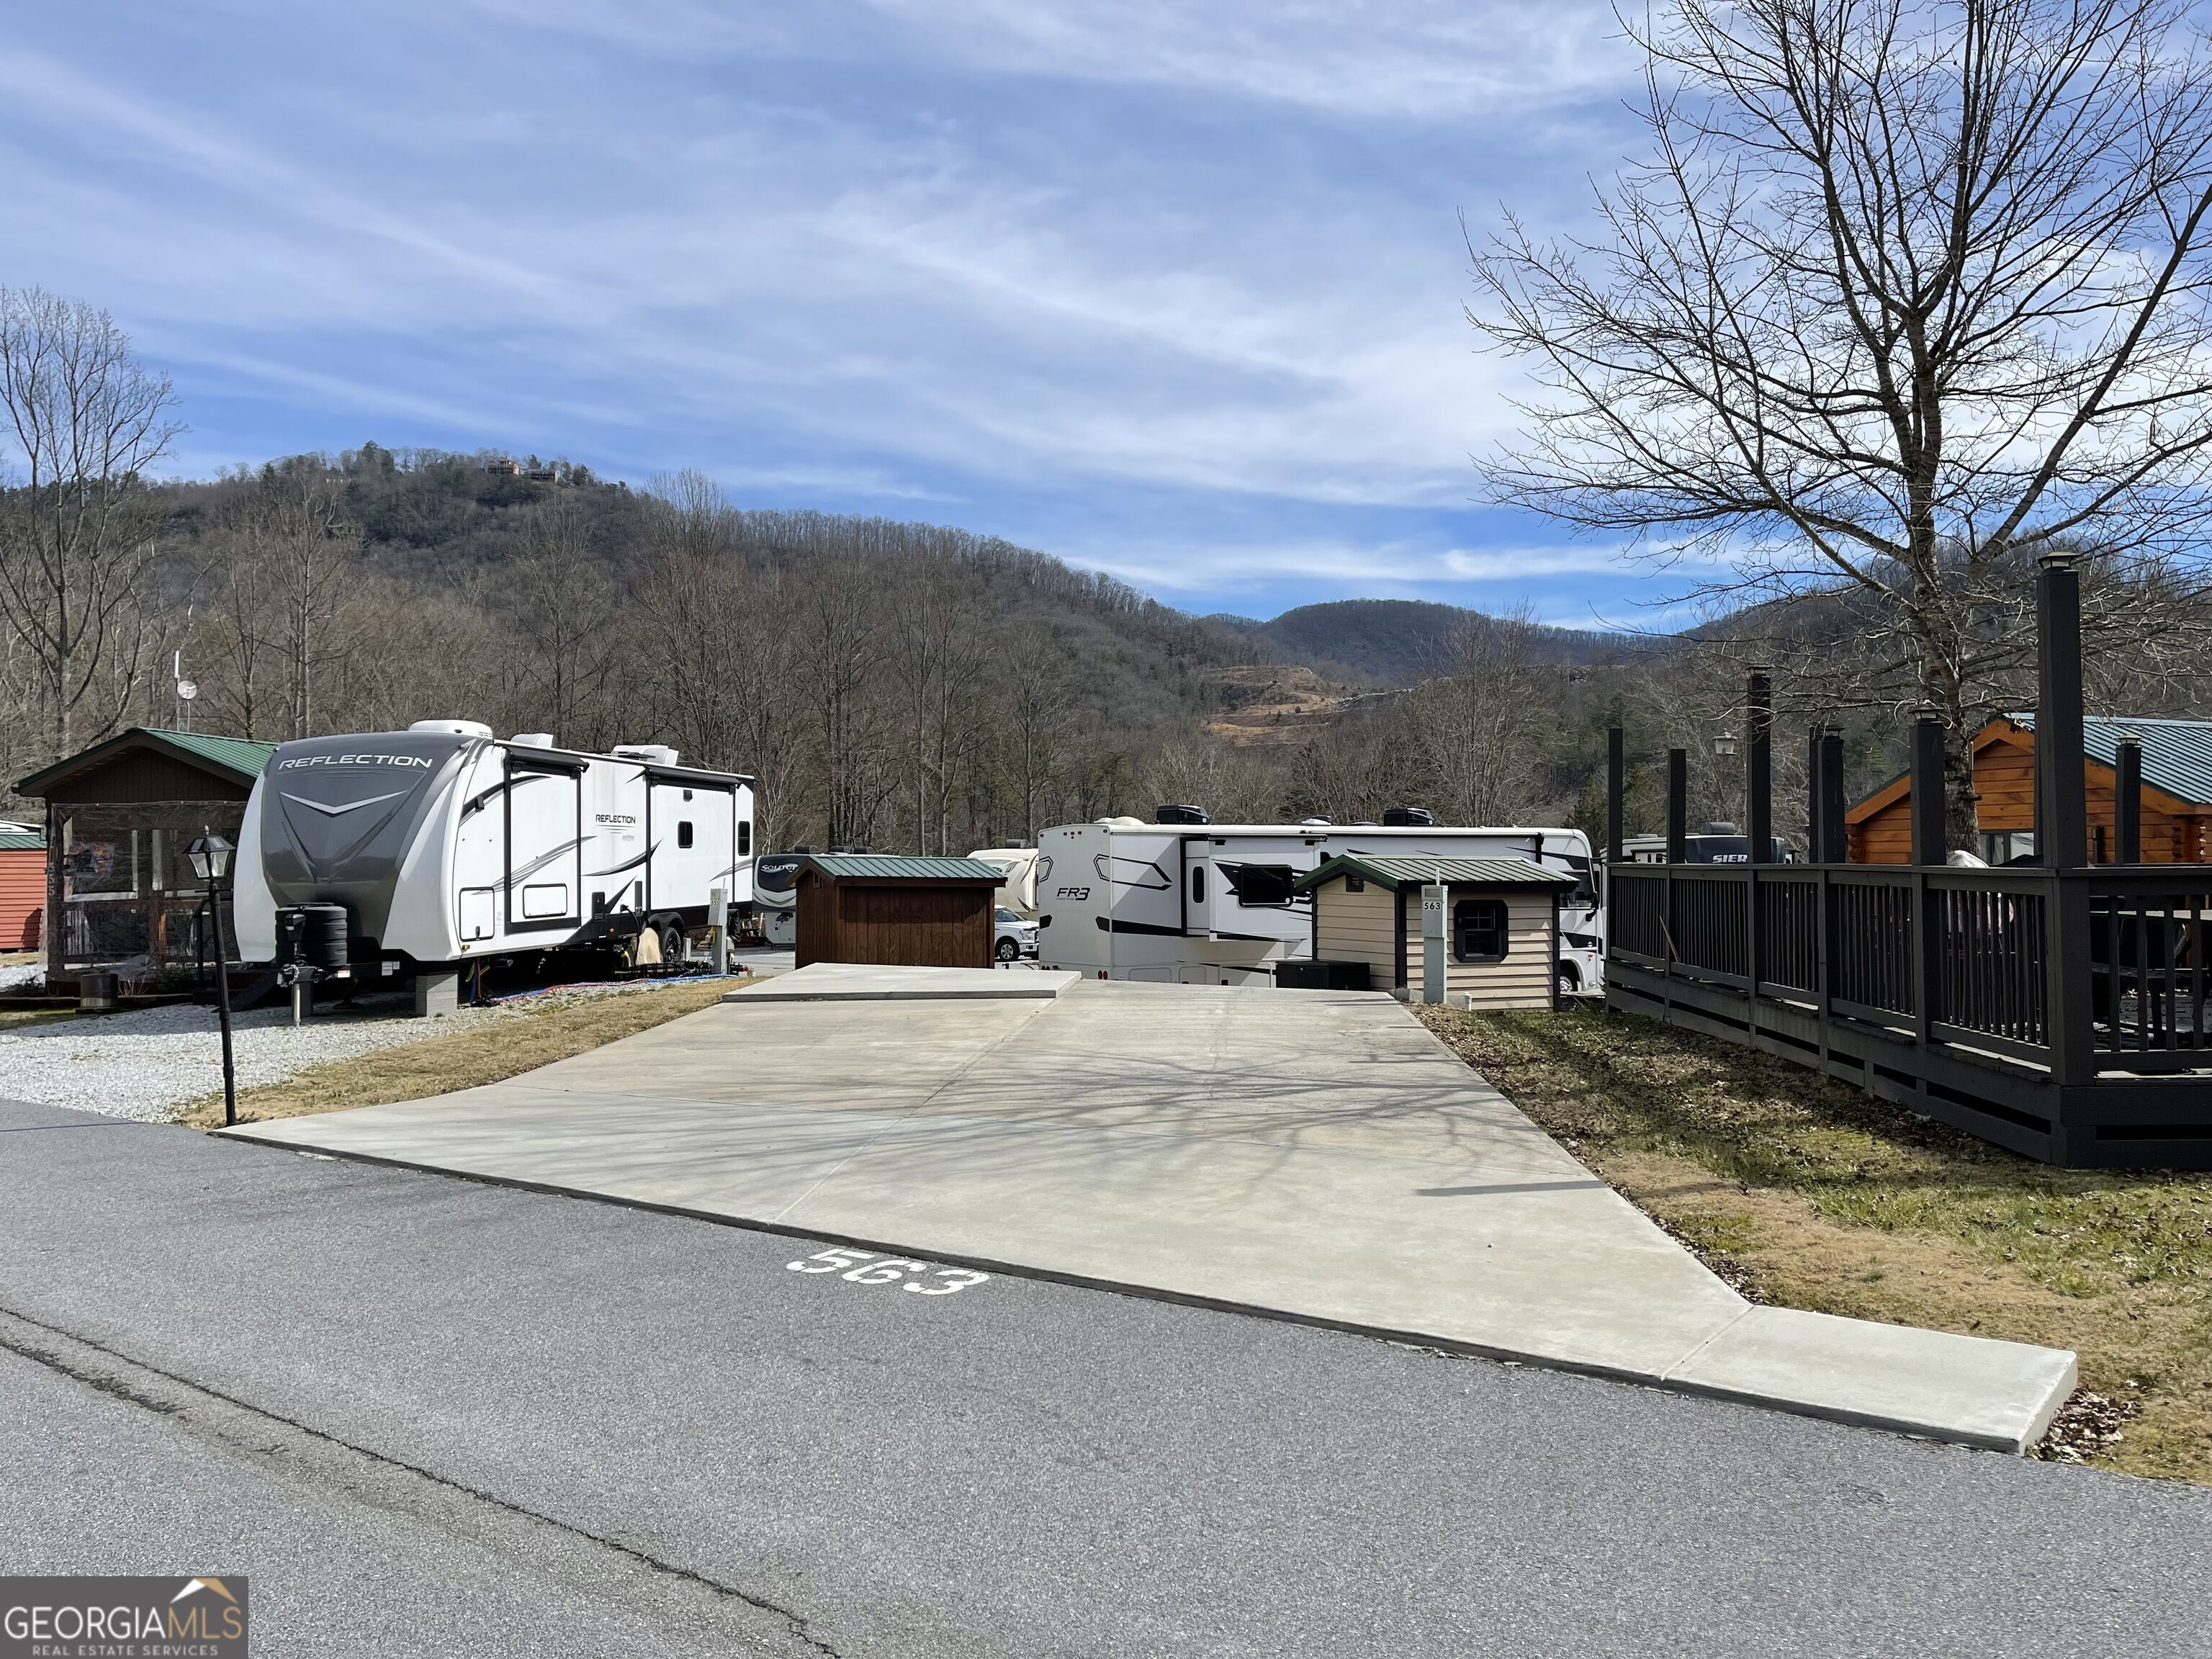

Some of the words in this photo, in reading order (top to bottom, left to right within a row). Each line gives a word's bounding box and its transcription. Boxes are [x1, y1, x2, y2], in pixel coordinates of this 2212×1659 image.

[278, 755, 433, 770] REFLECTION
[595, 814, 636, 824] REFLECTION
[1056, 887, 1091, 901] FR3
[1424, 902, 1441, 910] 563
[786, 1249, 989, 1295] 563
